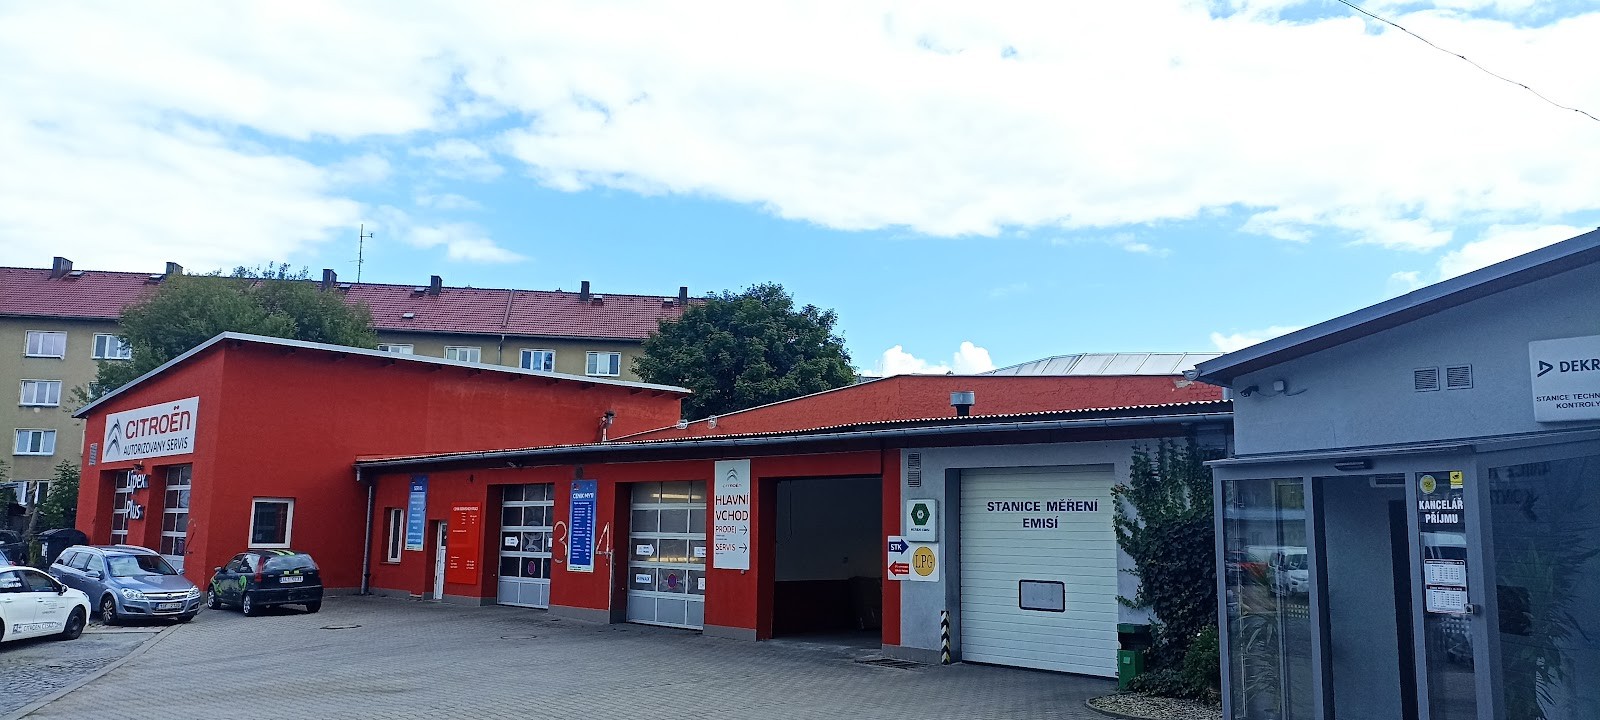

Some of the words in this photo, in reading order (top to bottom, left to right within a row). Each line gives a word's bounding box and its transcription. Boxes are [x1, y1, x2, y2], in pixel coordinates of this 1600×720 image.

[1536, 394, 1570, 402] STANICE
[1556, 401, 1600, 409] KONTROLY
[166, 436, 189, 451] SERVIS
[126, 469, 147, 495] Lipex
[715, 492, 749, 506] HLAVNÍ
[986, 501, 1041, 512] STANICE
[1046, 498, 1099, 512] MĚŘENÍ
[1418, 497, 1464, 510] KANCELÁŘ
[125, 499, 141, 520] Plus
[715, 510, 749, 521] VCHOD
[1022, 515, 1059, 529] EMISÍ
[1425, 511, 1459, 524] PŘÍJMU
[715, 525, 737, 534] PRODEJ
[715, 543, 736, 552] SERVIS
[890, 543, 903, 551] STK
[914, 554, 933, 569] LPG
